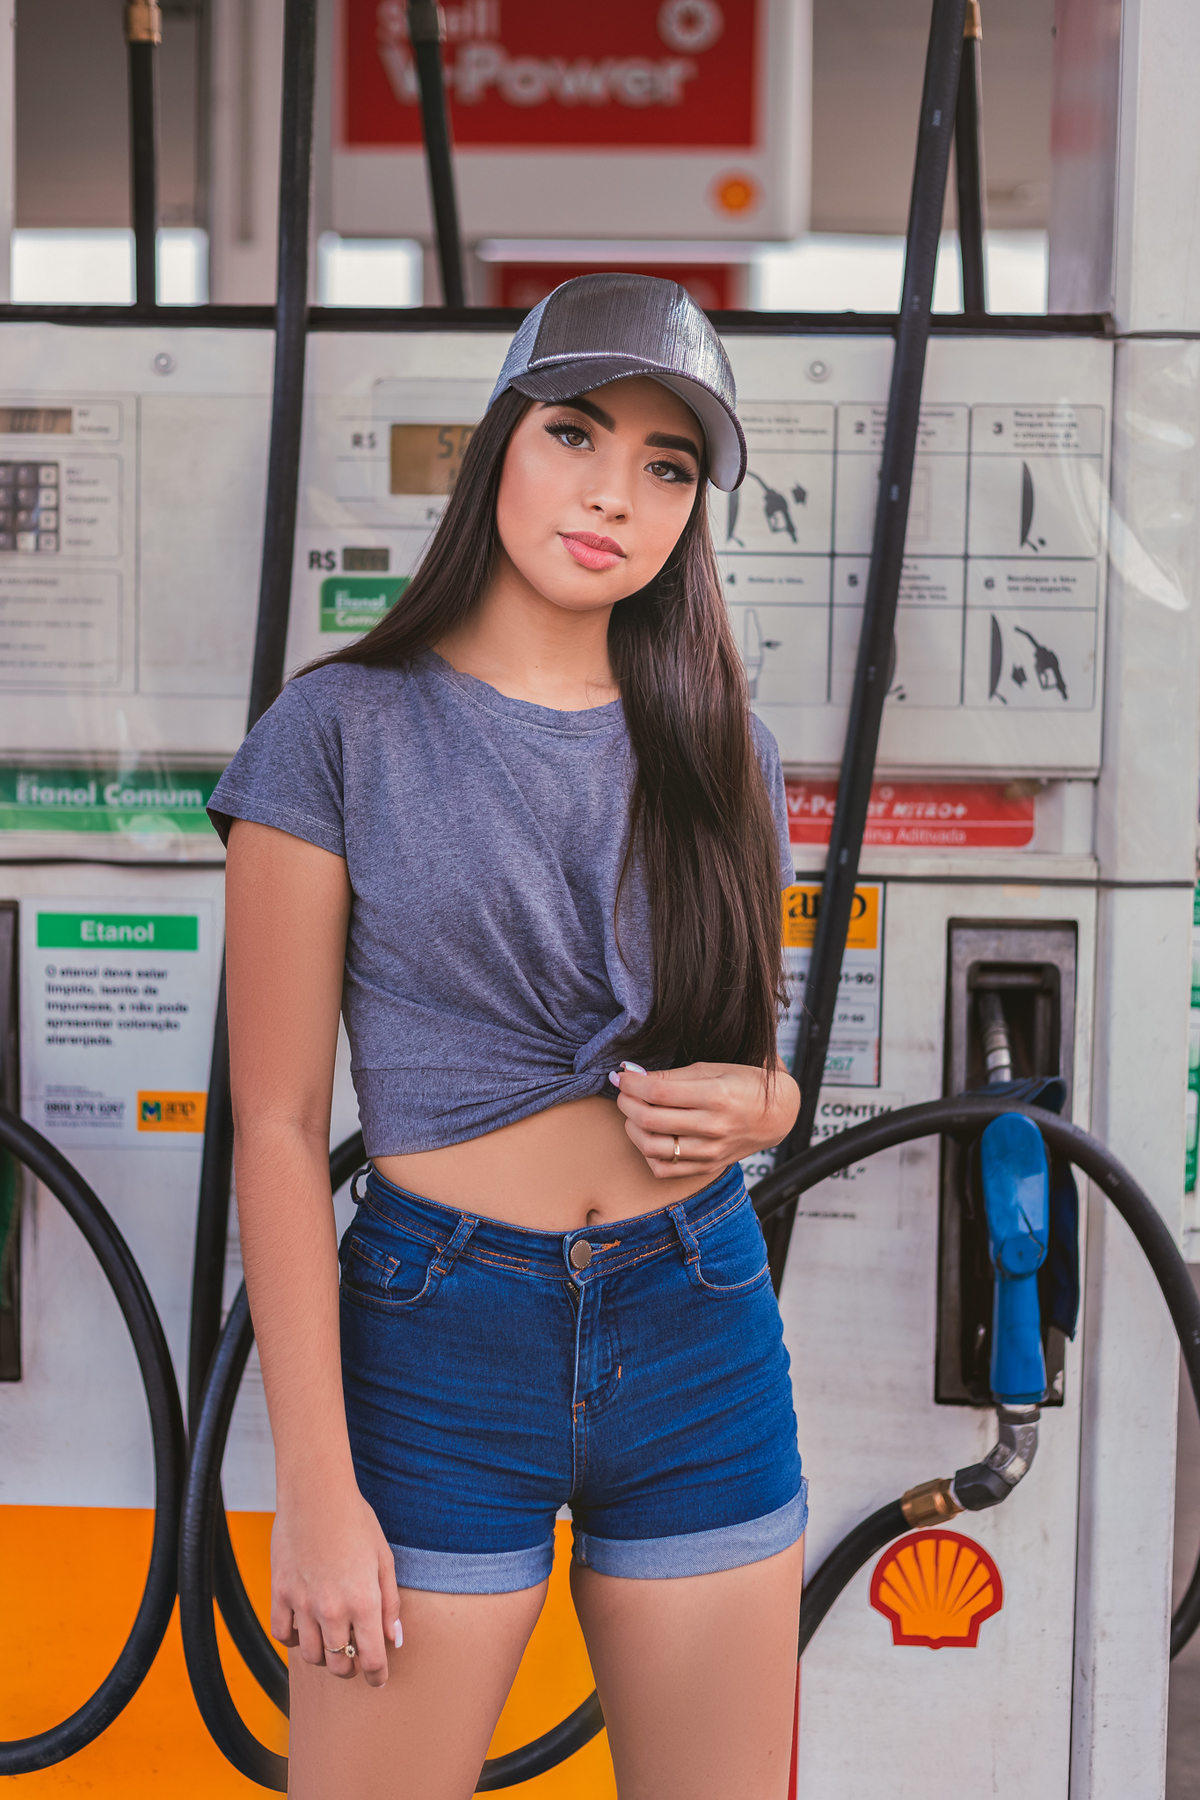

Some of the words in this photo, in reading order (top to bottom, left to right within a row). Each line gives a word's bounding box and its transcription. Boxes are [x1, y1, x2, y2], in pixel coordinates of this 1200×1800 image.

[377, 0, 501, 37] Sell
[993, 421, 1003, 435] 3
[727, 573, 736, 586] 4
[983, 576, 996, 591] 6
[334, 611, 385, 628] Com
[17, 782, 96, 806] Etanol
[104, 782, 203, 808] Comum
[788, 794, 889, 817] V-Por
[896, 827, 967, 845] Aditivada
[80, 919, 155, 943] Etanol
